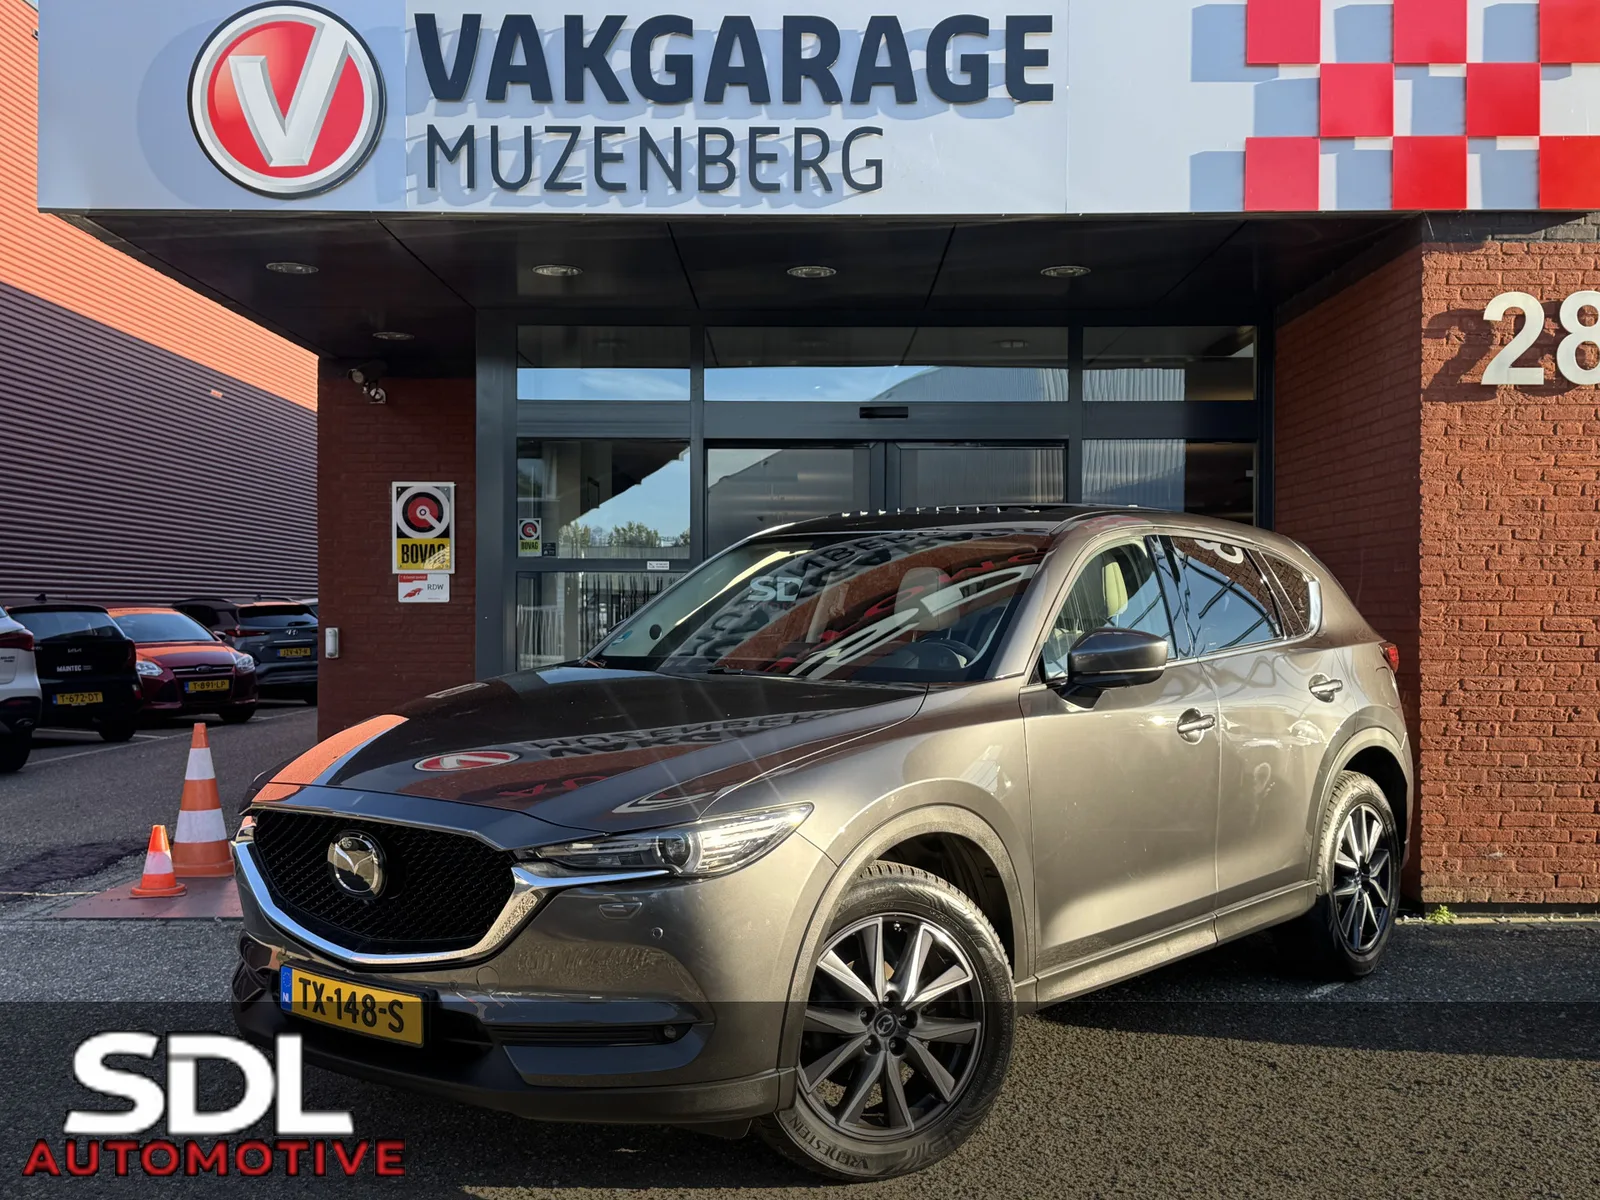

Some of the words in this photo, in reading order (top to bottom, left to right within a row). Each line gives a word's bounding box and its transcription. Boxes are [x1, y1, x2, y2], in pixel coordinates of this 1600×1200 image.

[415, 13, 1054, 104] VAKGARAGE
[228, 18, 348, 167] V
[426, 125, 884, 193] MUZENBERG
[1481, 290, 1600, 386] 28
[520, 541, 539, 550] BOVAG
[56, 664, 82, 672] MAINTEC
[282, 992, 291, 1003] NL
[298, 977, 404, 1034] TX-148-S
[788, 1115, 869, 1169] VREDESTEIN
